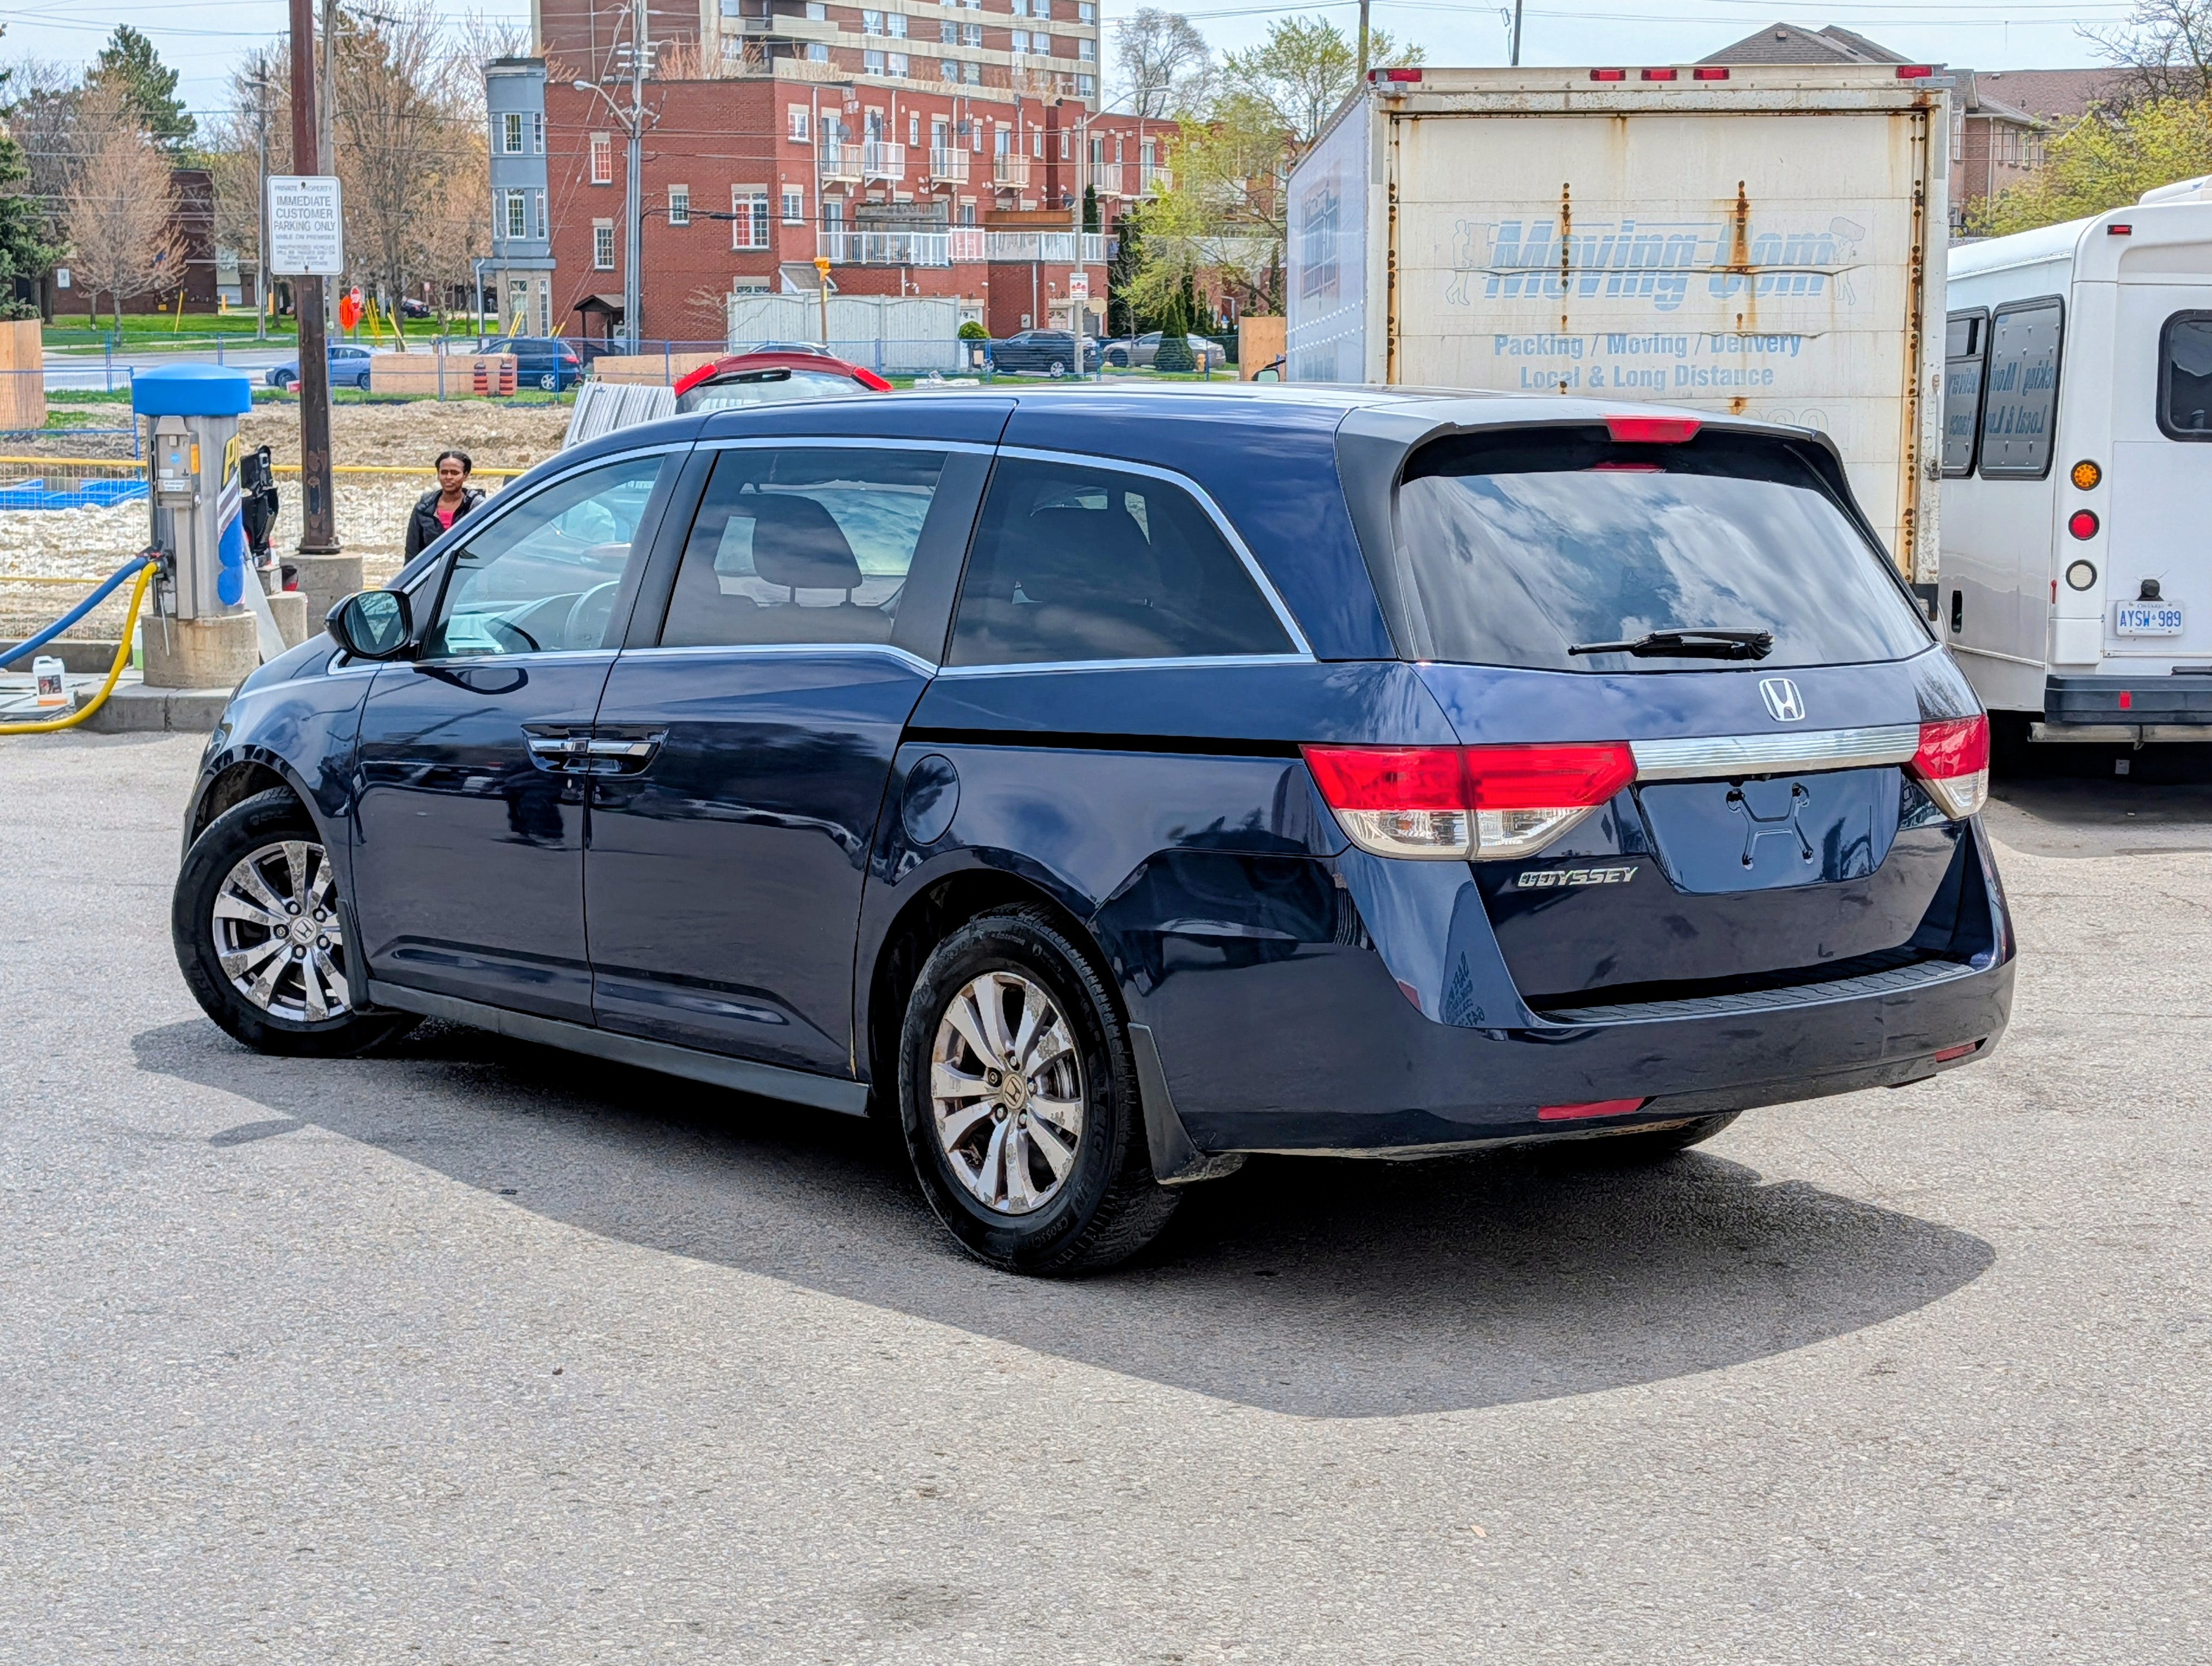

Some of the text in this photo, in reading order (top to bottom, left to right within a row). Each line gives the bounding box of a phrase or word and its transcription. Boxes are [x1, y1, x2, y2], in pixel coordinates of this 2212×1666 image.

[276, 196, 331, 207] IMMEDIATE
[276, 208, 333, 219] CUSTOMER
[274, 220, 336, 232] PARKING ONLY
[1484, 220, 1697, 311] Moving
[1495, 334, 1583, 359] Packing
[1606, 333, 1687, 358] Moving
[1711, 335, 1802, 357] Delivery
[1521, 364, 1774, 392] Local & Long Distance
[2158, 611, 2182, 627] 989
[1517, 866, 1639, 887] ODYSSEY
